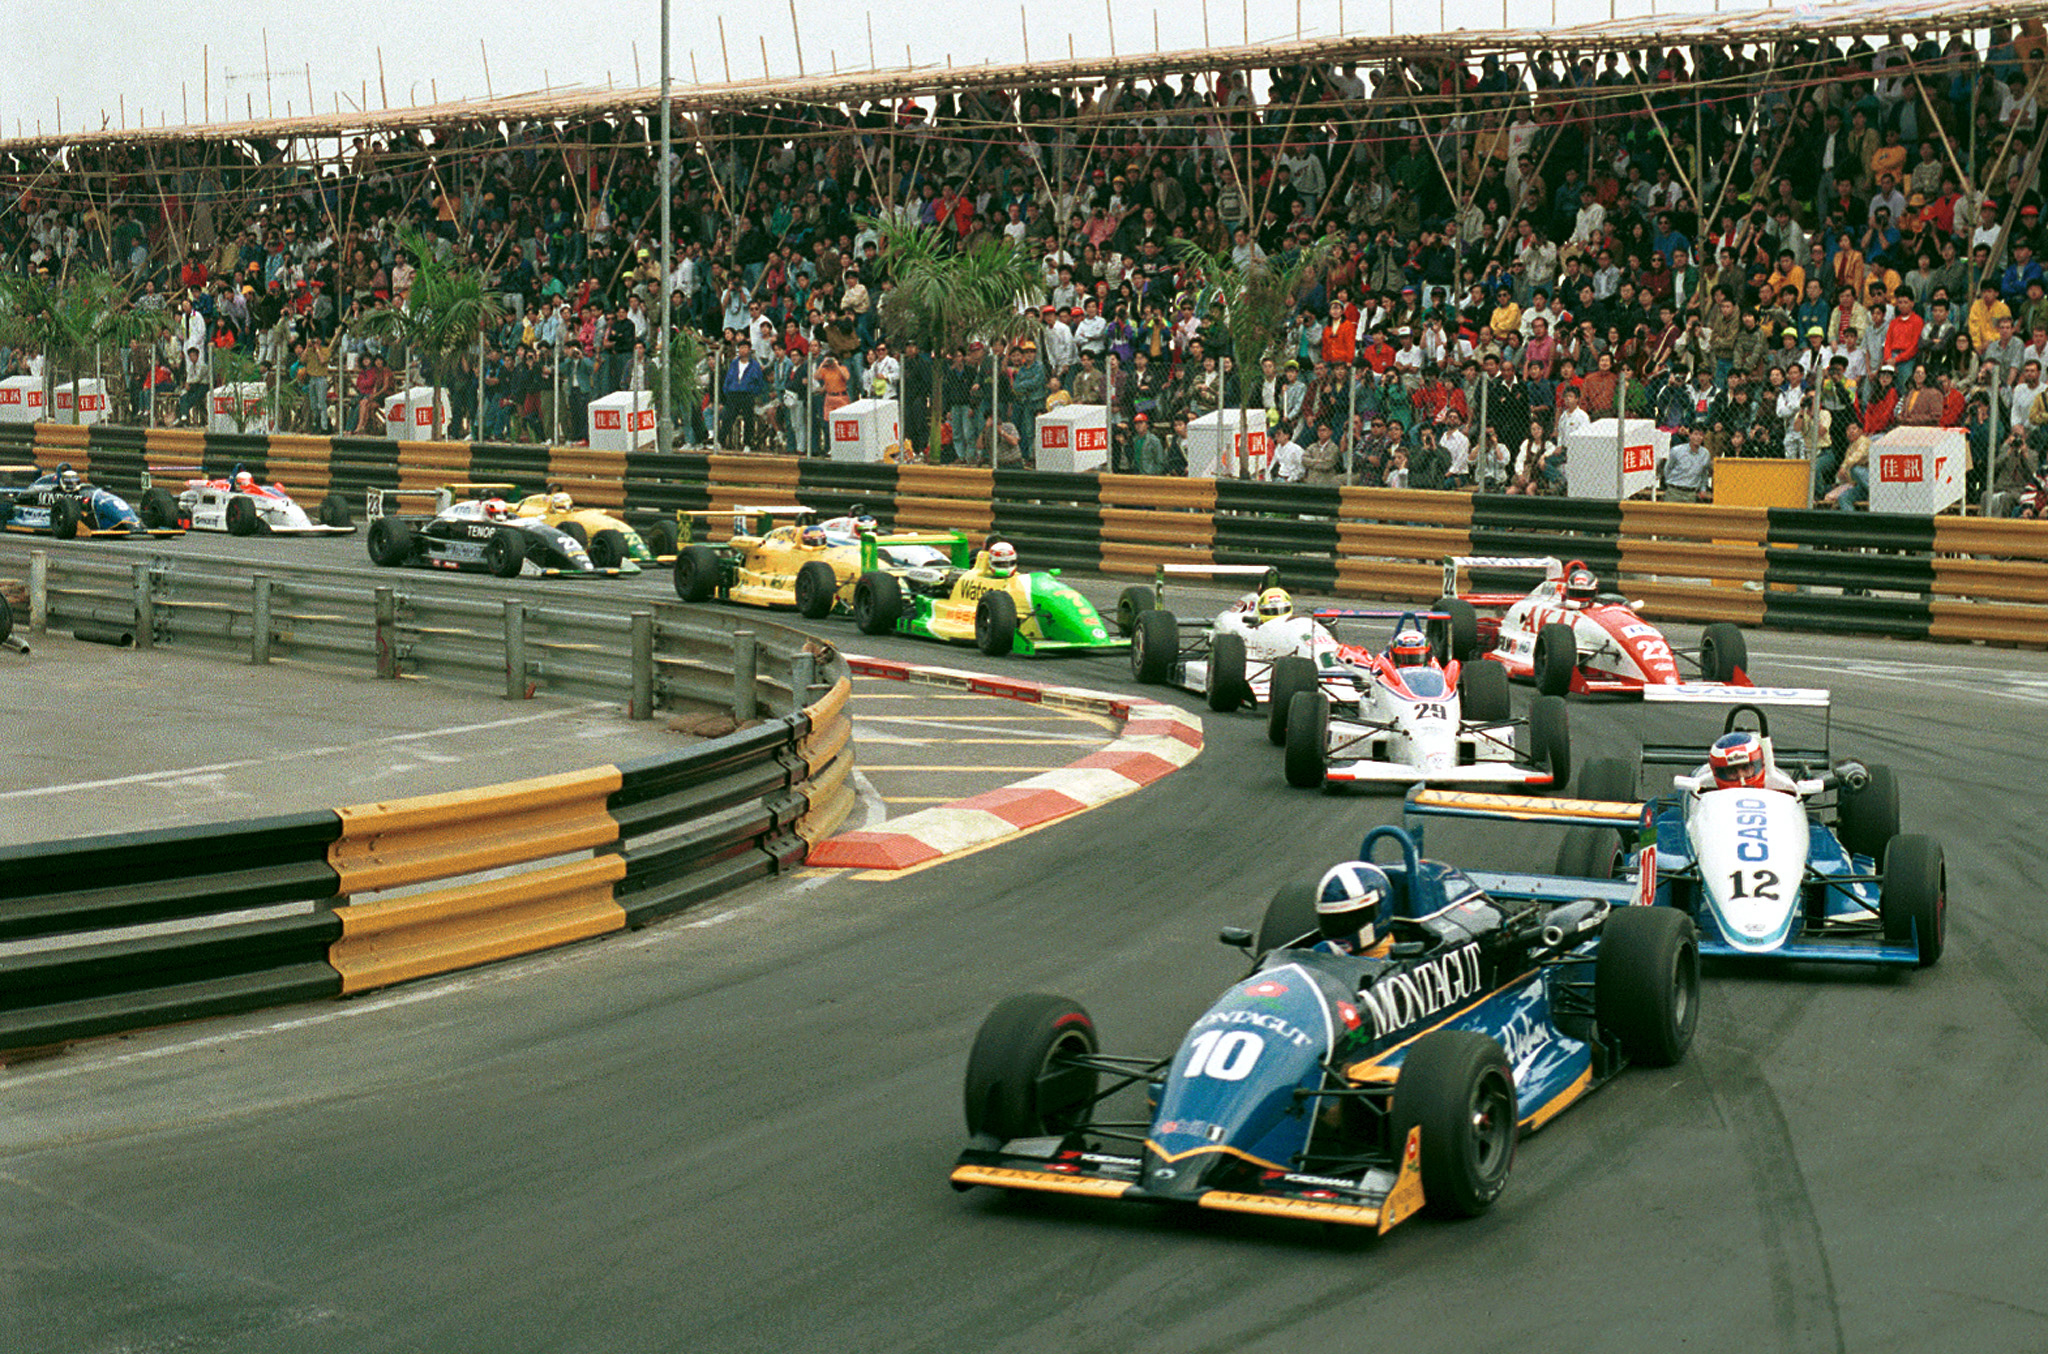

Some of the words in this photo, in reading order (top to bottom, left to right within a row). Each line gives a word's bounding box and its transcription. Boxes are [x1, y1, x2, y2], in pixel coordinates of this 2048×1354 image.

[1636, 640, 1673, 661] 22
[1414, 702, 1447, 720] 29
[1736, 798, 1769, 863] CASIO
[1641, 846, 1656, 906] 10
[1729, 870, 1780, 901] 12
[1357, 941, 1482, 1040] MONTAGUT
[1184, 1029, 1265, 1081] 10
